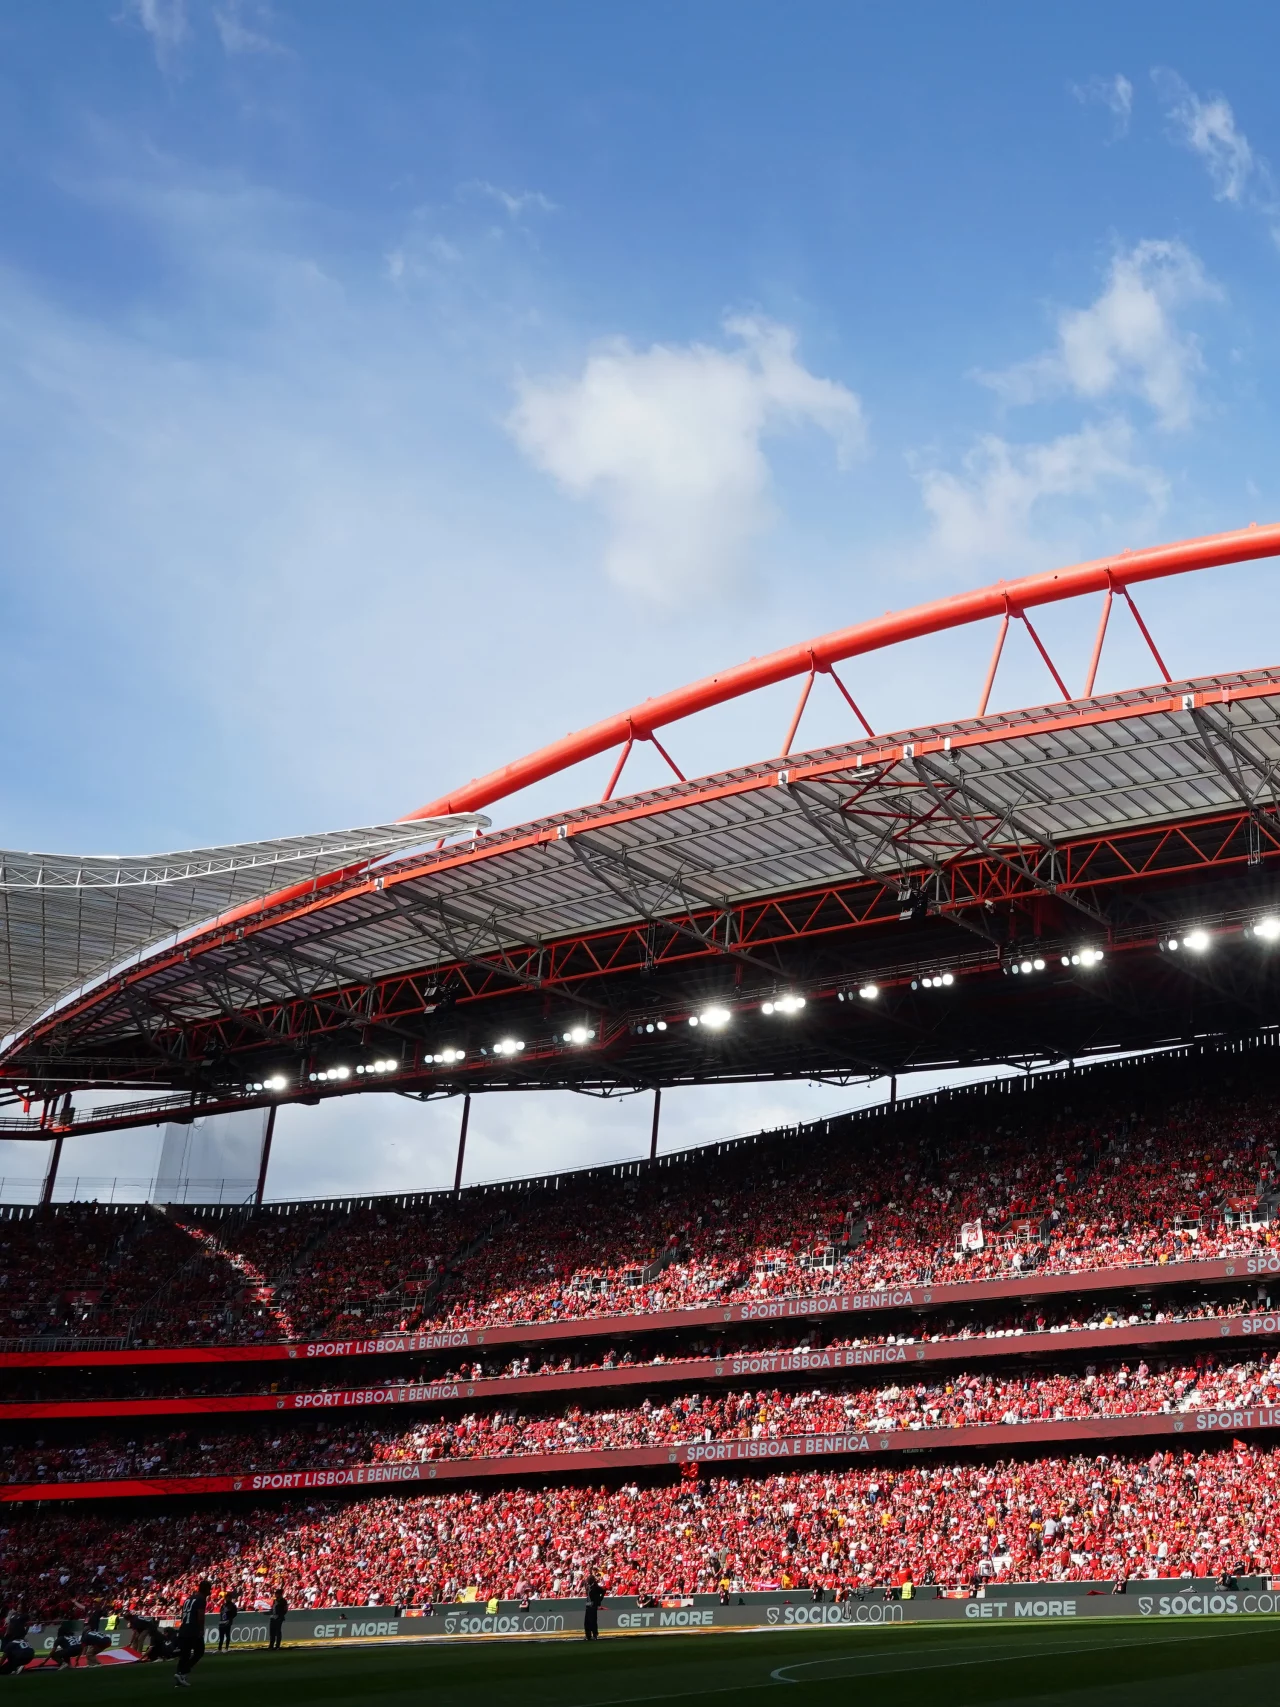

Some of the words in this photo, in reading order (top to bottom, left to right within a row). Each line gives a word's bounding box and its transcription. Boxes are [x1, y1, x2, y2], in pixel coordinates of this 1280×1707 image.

[741, 1303, 785, 1319] SPORT
[789, 1298, 837, 1315] LISBOA
[842, 1297, 848, 1309] E
[853, 1292, 913, 1309] BENFICA
[307, 1343, 352, 1356] SPORT
[356, 1339, 404, 1354] LISBOA
[409, 1337, 415, 1350] E
[419, 1333, 468, 1349] BENFICA
[733, 1358, 777, 1373] SPORT
[781, 1353, 829, 1370] LISBOA
[835, 1352, 841, 1364] E
[846, 1348, 906, 1364] BENFICA
[295, 1394, 340, 1407] SPORT
[344, 1391, 393, 1405] LISBOA
[398, 1389, 405, 1401] E
[409, 1386, 459, 1400] BENFICA
[1196, 1412, 1253, 1430] SPORT
[687, 1445, 733, 1460] SPORT
[737, 1439, 789, 1457] LISBOA
[794, 1439, 800, 1453] E
[805, 1436, 869, 1453] BENFICA
[253, 1474, 301, 1488] SPORT
[304, 1470, 354, 1486] LISBOA
[357, 1469, 363, 1482] E
[367, 1466, 420, 1481] BENFICA
[617, 1613, 655, 1628] GET
[659, 1611, 714, 1626] MORE
[965, 1602, 1008, 1618] GET
[1014, 1600, 1076, 1616] MORE
[313, 1623, 347, 1638] GET
[351, 1621, 399, 1637] MORE
[460, 1614, 564, 1634] SOCIOS.com
